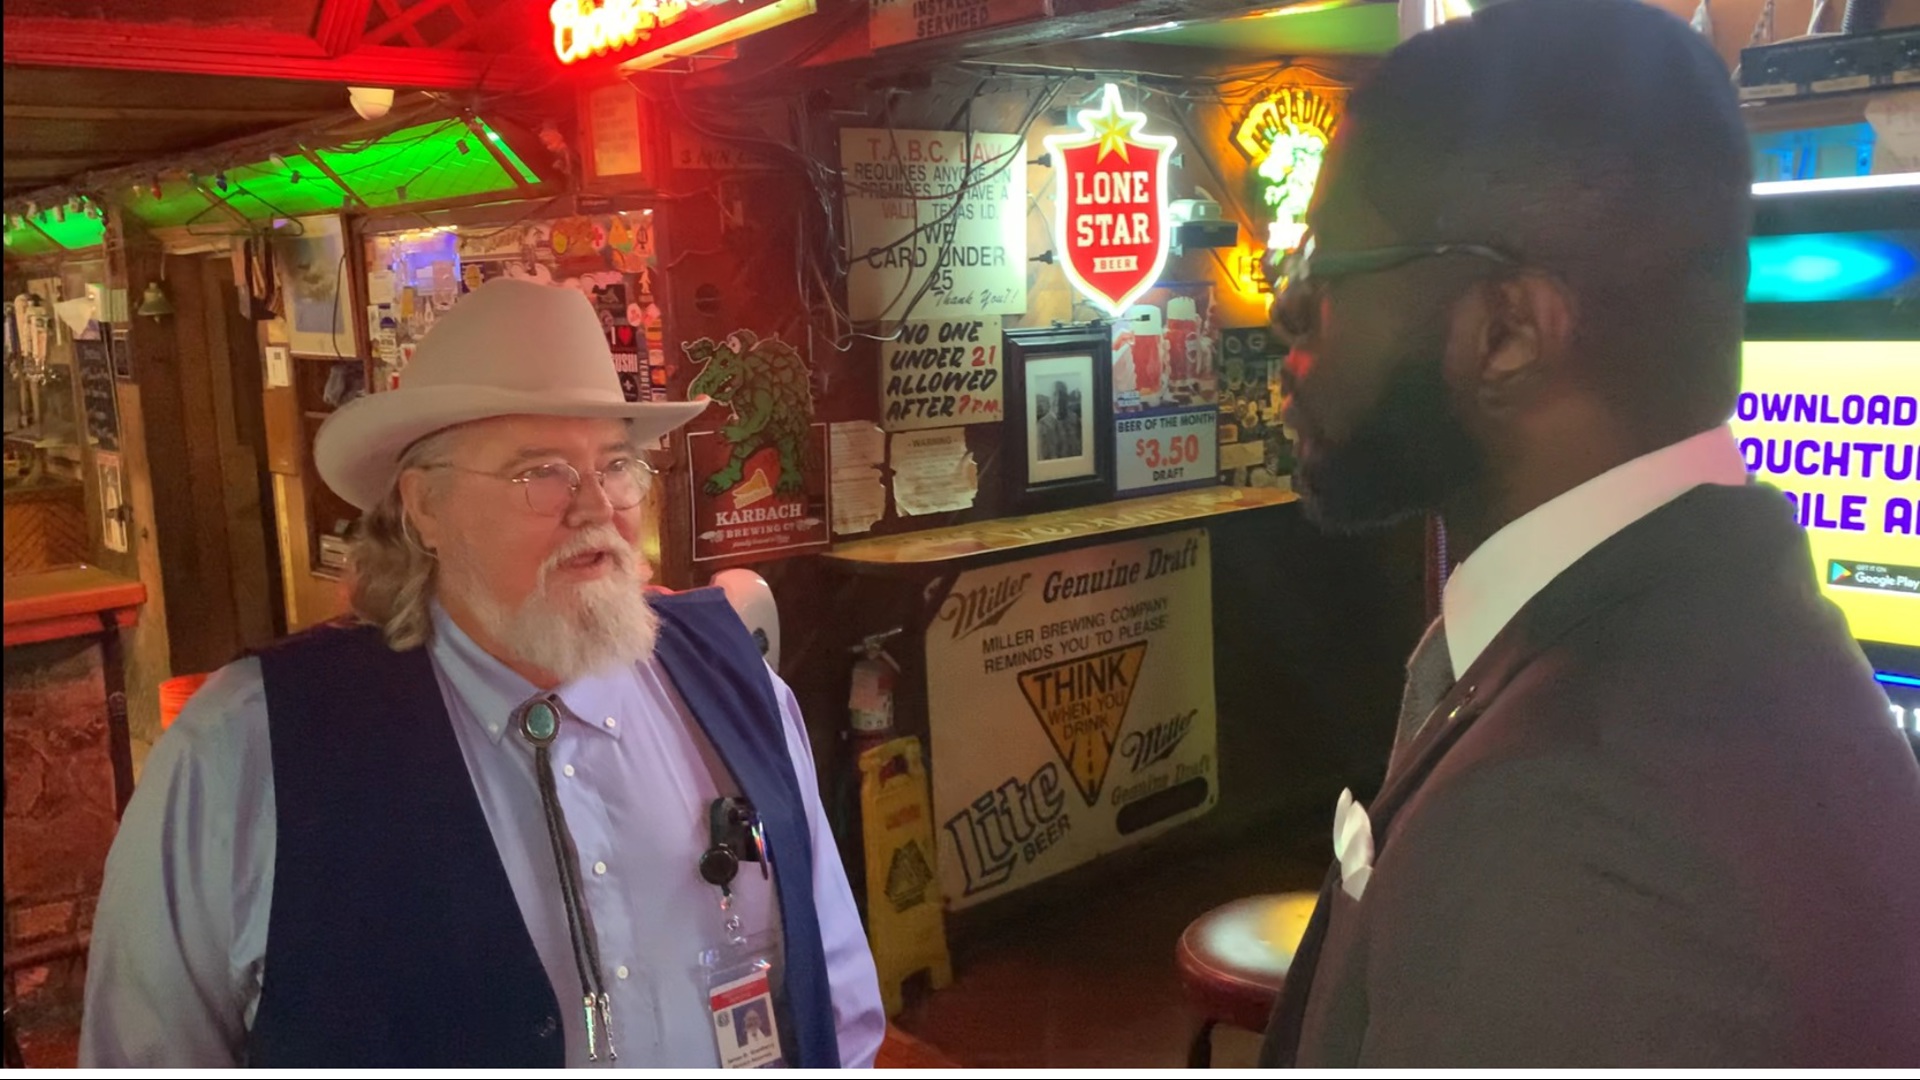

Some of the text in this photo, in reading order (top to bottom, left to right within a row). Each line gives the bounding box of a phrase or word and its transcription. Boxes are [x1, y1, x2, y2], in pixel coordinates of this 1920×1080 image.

[917, 6, 989, 36] SERVICED
[867, 138, 1002, 163] T.A.B.C. LAW
[855, 163, 926, 182] REQUIRES
[933, 166, 985, 184] ANYONE
[860, 182, 1009, 200] PREMISES TO HAVE A
[1075, 171, 1149, 205] LONE
[932, 203, 974, 220] TEXAS
[923, 223, 954, 243] WE
[1077, 213, 1151, 247] STAR
[868, 246, 1006, 269] CARD UNDER
[1100, 259, 1132, 270] BEER
[930, 270, 954, 290] 25
[934, 290, 974, 307] Thank
[896, 320, 983, 345] NO ONE
[889, 345, 997, 370] UNDER 21
[886, 368, 998, 396] ALLOWED
[886, 395, 956, 421] AFTER
[1737, 392, 1918, 426] OWNLOAD
[1117, 412, 1215, 433] BEER OF THE MONTH
[911, 436, 952, 448] WARNING
[1136, 434, 1199, 468] $3.50
[1735, 437, 1920, 481] OUCHTU
[1153, 467, 1184, 482] DRAFT
[716, 503, 802, 527] KARBACH
[1884, 497, 1920, 536] A
[726, 523, 781, 539] BREWING
[938, 538, 1199, 642] Miller Genuine Draft
[1855, 571, 1920, 590] Google Play
[982, 597, 1169, 654] MILLER BREWING COMPANY
[984, 613, 1169, 674] REMINDS YOU TO PLEASE
[1033, 654, 1129, 710] THINK
[1048, 690, 1126, 726] WHEN YOU
[1120, 708, 1199, 773] Miller
[943, 761, 1066, 897] Lite
[1023, 813, 1071, 864] BEER
